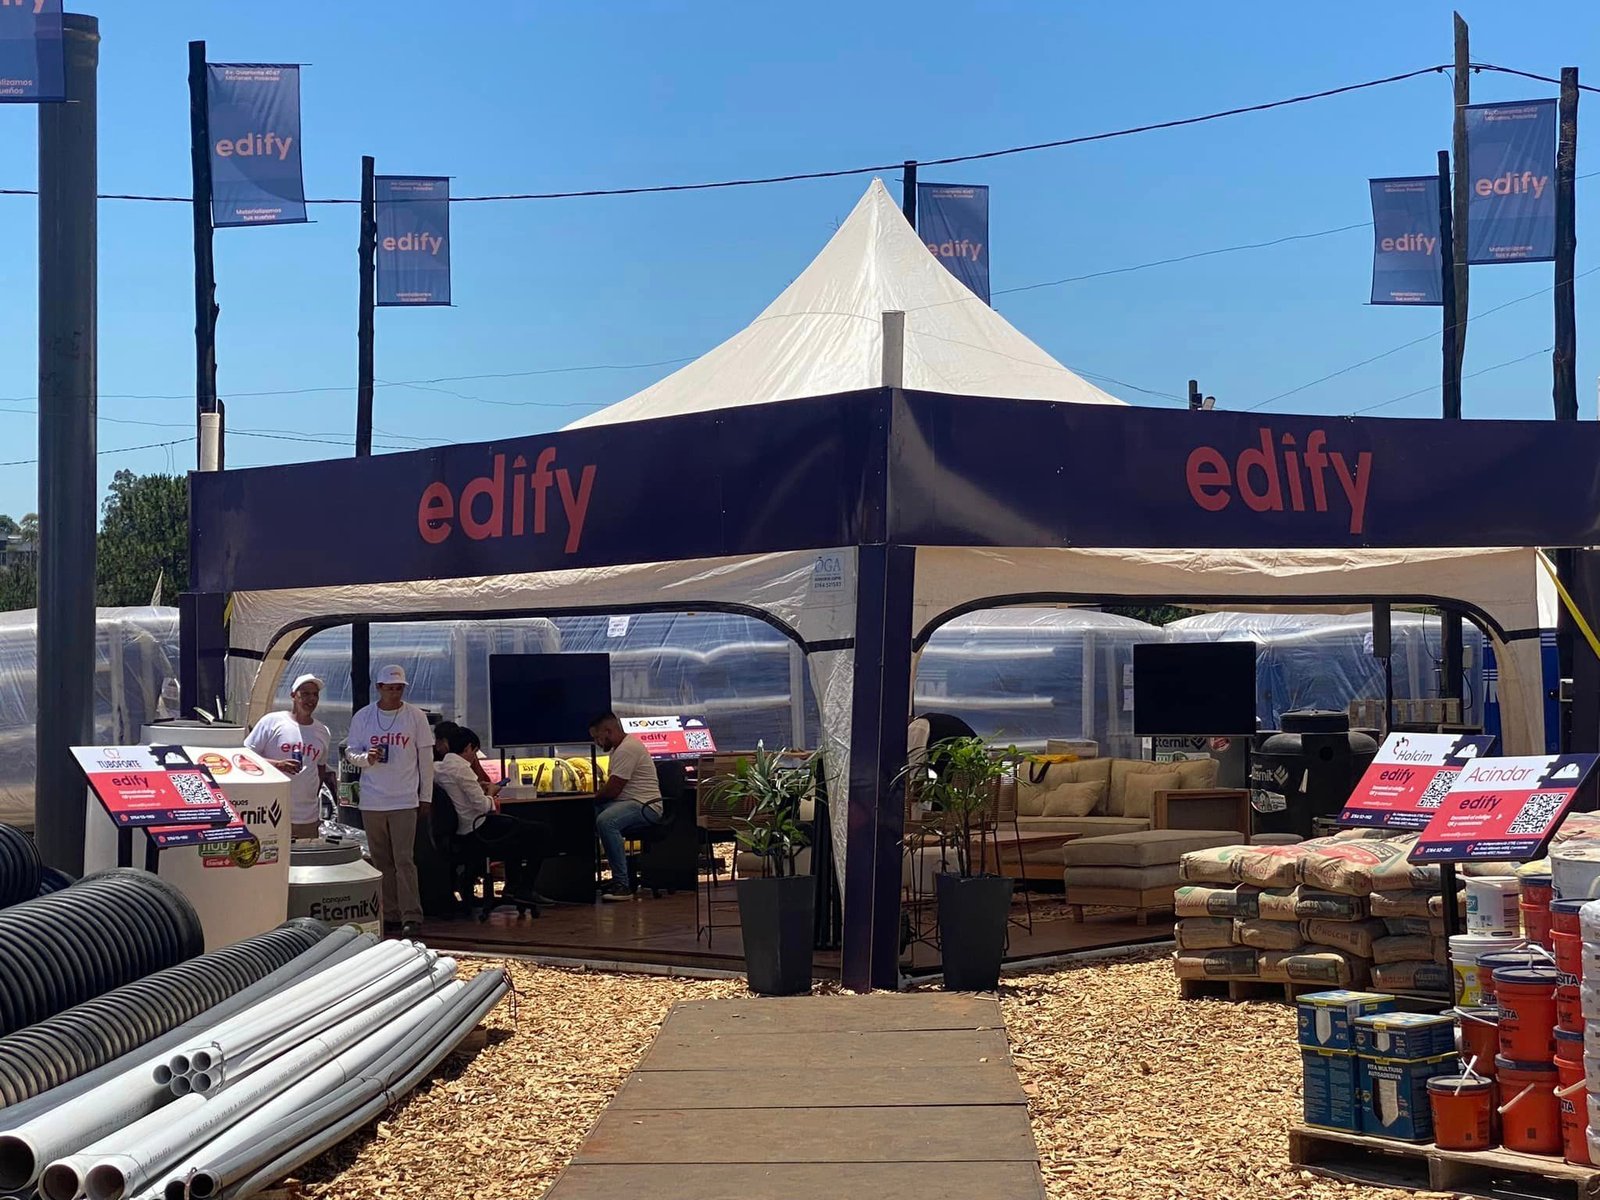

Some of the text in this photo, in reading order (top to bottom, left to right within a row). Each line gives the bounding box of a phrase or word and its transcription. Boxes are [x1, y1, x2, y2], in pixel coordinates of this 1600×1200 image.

[215, 132, 293, 160] edify
[1475, 171, 1548, 199] edify
[382, 232, 442, 255] edify
[927, 239, 982, 262] edify
[1381, 233, 1436, 256] edify
[1185, 428, 1373, 535] edify
[418, 447, 597, 555] edify
[370, 732, 410, 750] edify
[641, 733, 667, 742] edify
[281, 742, 320, 761] edify
[1396, 750, 1432, 762] Holcim
[96, 760, 142, 769] TUBOFORTE
[1464, 765, 1534, 783] Acindar
[112, 775, 149, 788] edify
[1380, 769, 1415, 784] edify
[1459, 795, 1502, 812] edify
[311, 900, 369, 921] Eternit
